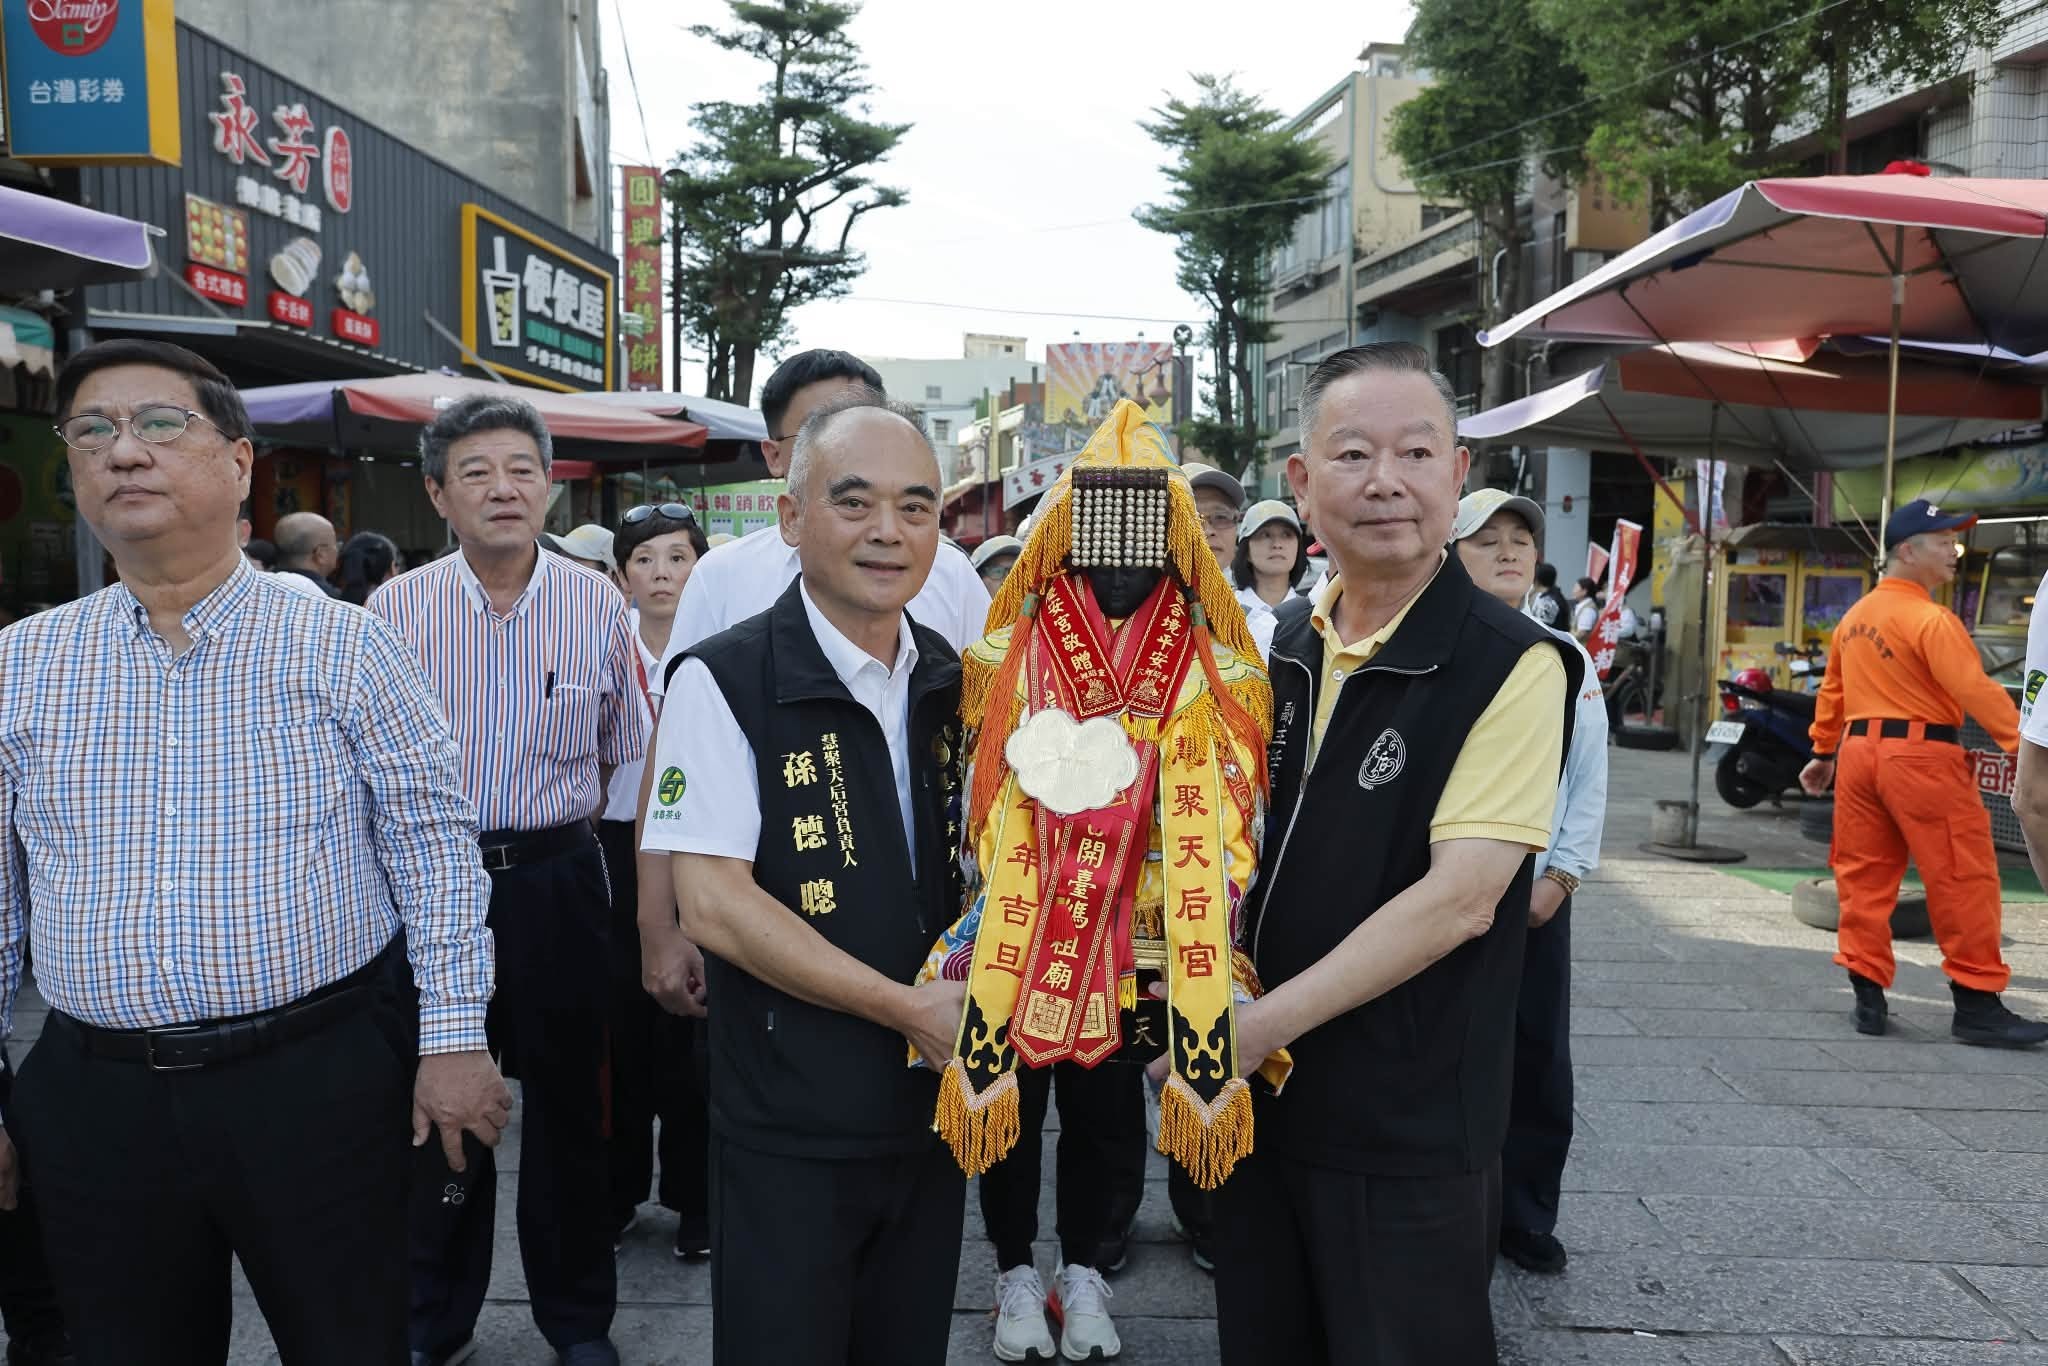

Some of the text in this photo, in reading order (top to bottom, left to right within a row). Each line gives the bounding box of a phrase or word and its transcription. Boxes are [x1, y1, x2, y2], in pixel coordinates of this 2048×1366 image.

[30, 78, 125, 104] 台灣彩券
[208, 72, 320, 193] 永芳
[820, 732, 858, 869] 慧聚天后宮負責人
[985, 797, 1040, 978] 年吉旦
[1040, 824, 1106, 992] 開臺媽祖廟
